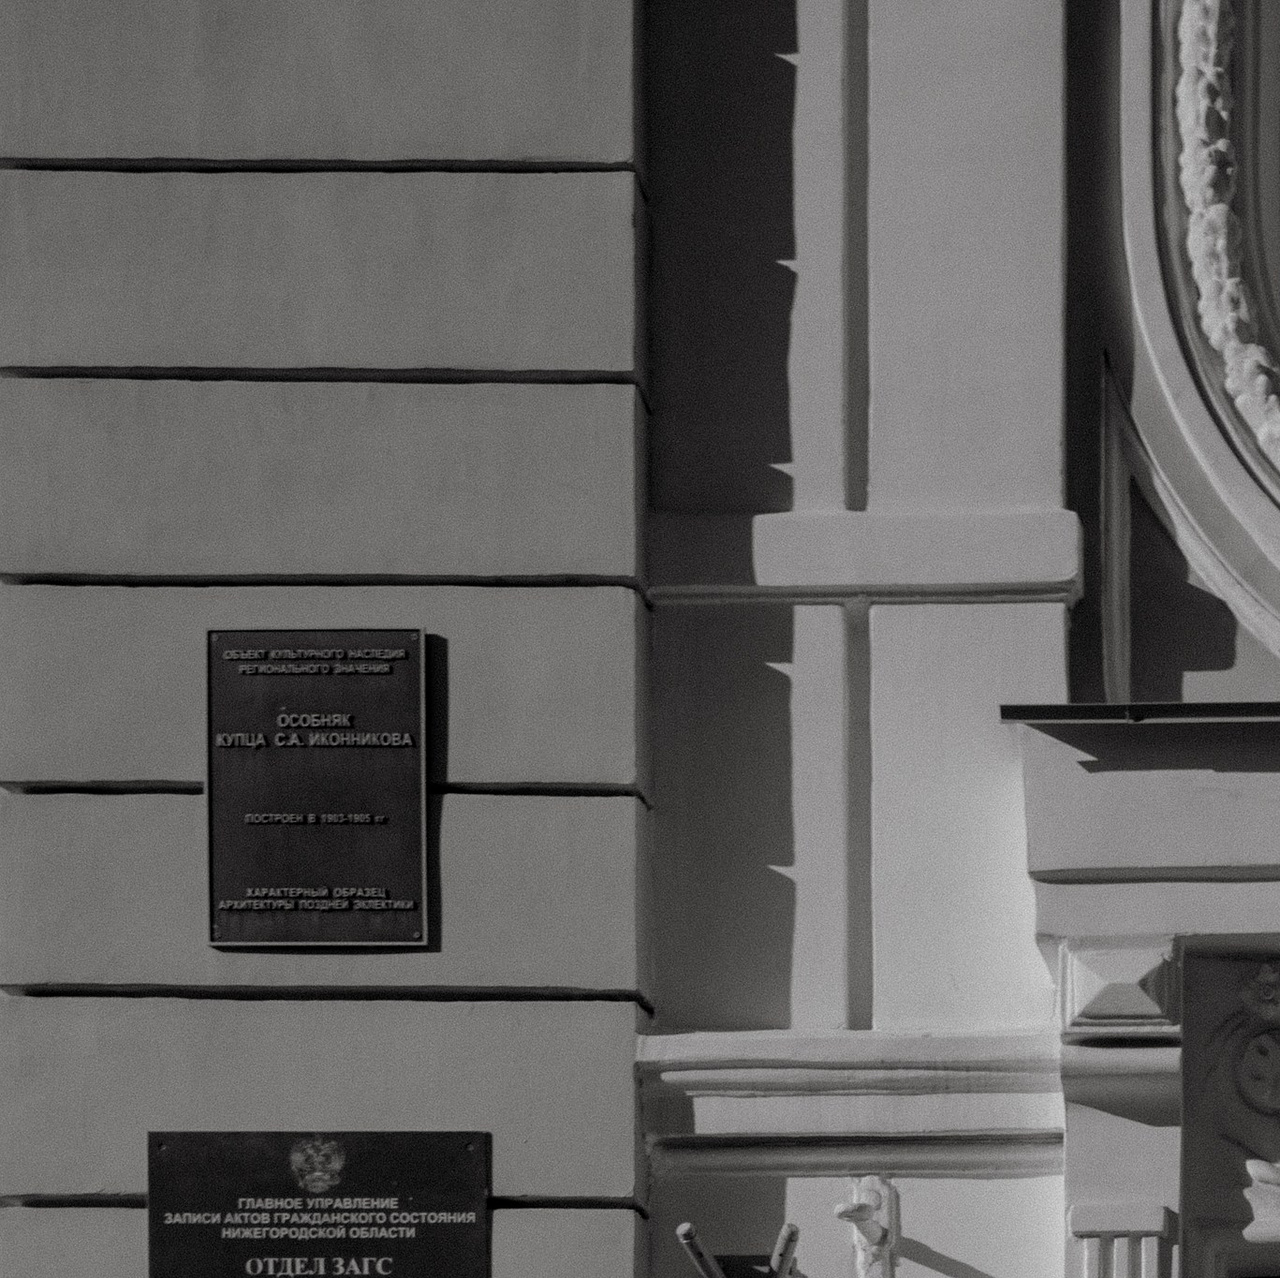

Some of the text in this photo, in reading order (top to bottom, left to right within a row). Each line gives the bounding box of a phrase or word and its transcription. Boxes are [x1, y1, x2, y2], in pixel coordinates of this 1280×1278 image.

[277, 714, 351, 727] ОСОБНЯК
[216, 733, 413, 748] КУПЦА С.А. ИКОННИКОВА
[245, 814, 303, 823] ПОСТРОЕН
[308, 814, 316, 823] В
[238, 1198, 399, 1209] ГЛАВНОЕ УПРАВЛЕНИЕ
[164, 1212, 476, 1226] ЗАПИСИ АКТОВ ГРАЖДАНСКОГО СОСТОЯНИЯ
[221, 1225, 416, 1240] НИЖЕГОРОДСКОЙ ОБЛАСТИ
[245, 1257, 393, 1278] ОТДЕЛ ЗАГС
